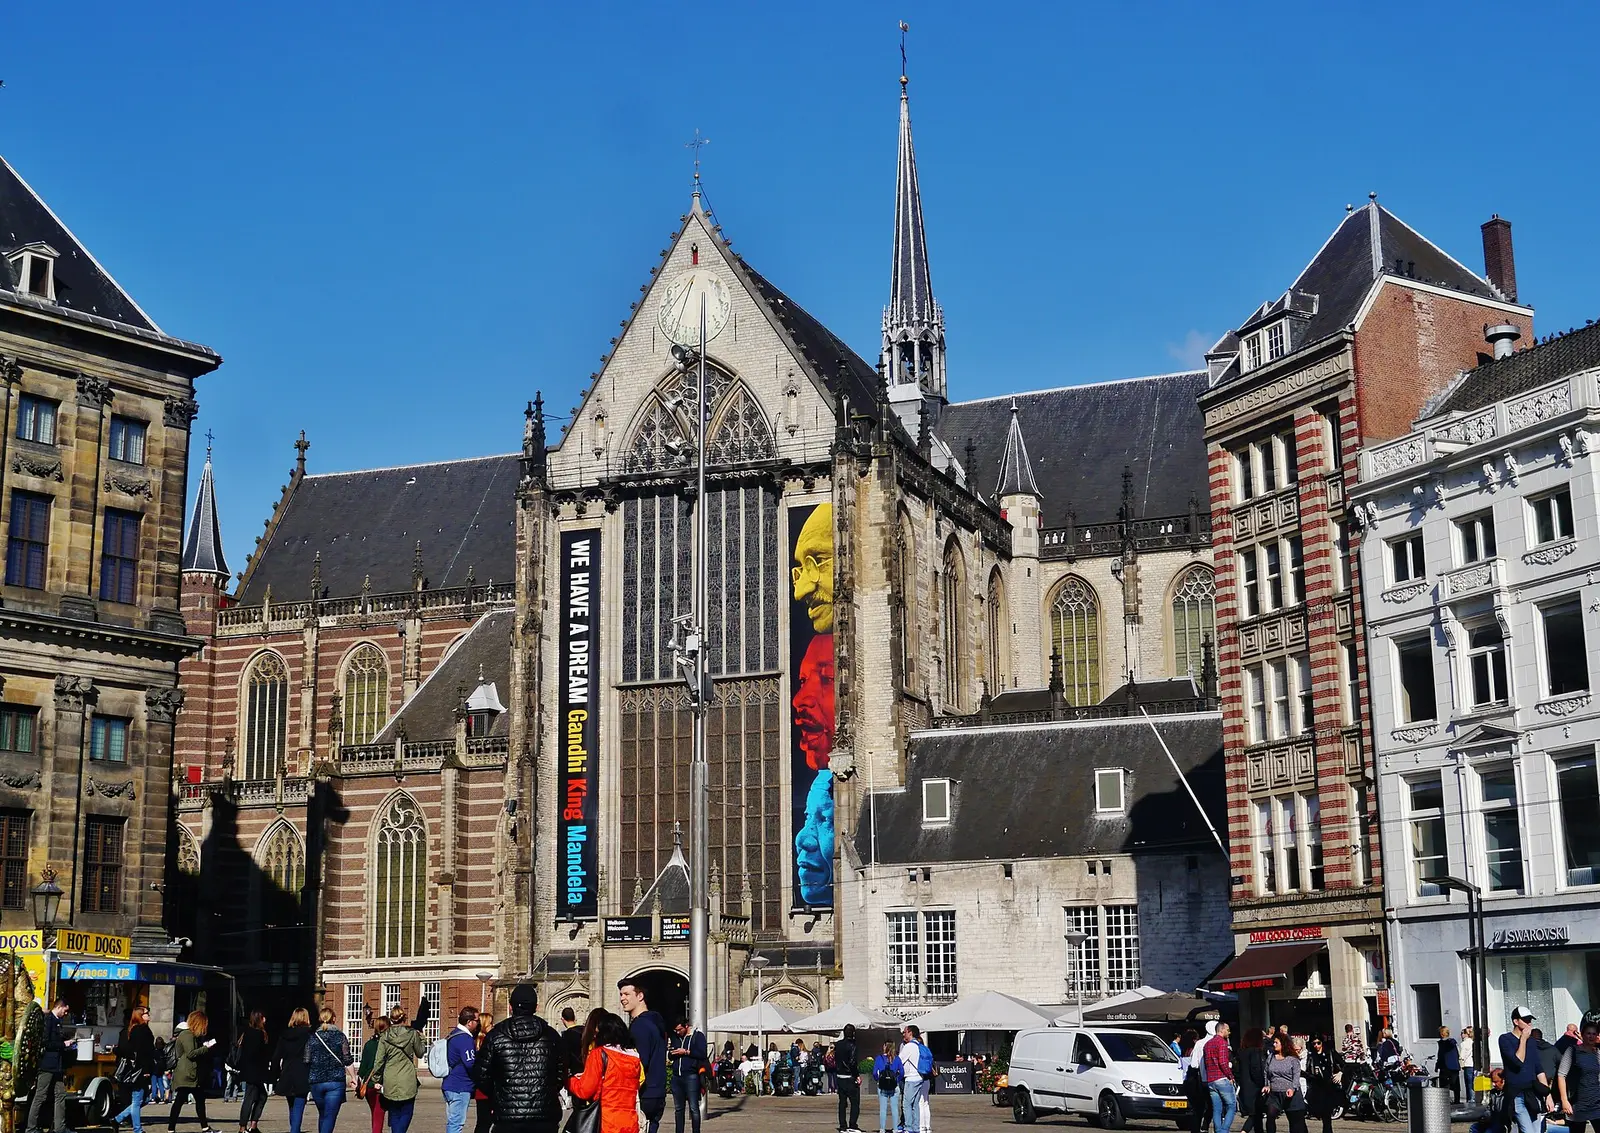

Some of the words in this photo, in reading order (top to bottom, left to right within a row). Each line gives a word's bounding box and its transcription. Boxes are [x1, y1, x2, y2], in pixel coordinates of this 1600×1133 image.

[715, 320, 721, 329] 2
[570, 539, 590, 568] WE
[569, 572, 590, 618] HAVE
[569, 623, 589, 636] A
[568, 640, 589, 704] DREAM
[567, 708, 588, 773] Gandhi
[563, 778, 587, 821] King
[567, 825, 587, 906] Mandela
[0, 934, 38, 949] DOGS
[1249, 931, 1267, 943] DAM
[1267, 929, 1291, 942] GOOD
[1292, 927, 1322, 940] COFFEE
[1507, 925, 1570, 943] SWAROVSKI
[66, 933, 91, 951] HOT
[95, 937, 122, 955] DOGS
[1235, 981, 1251, 989] GOOD
[1252, 979, 1273, 988] COFFEE
[940, 1065, 967, 1074] Breakfast
[945, 1081, 963, 1089] Lunch
